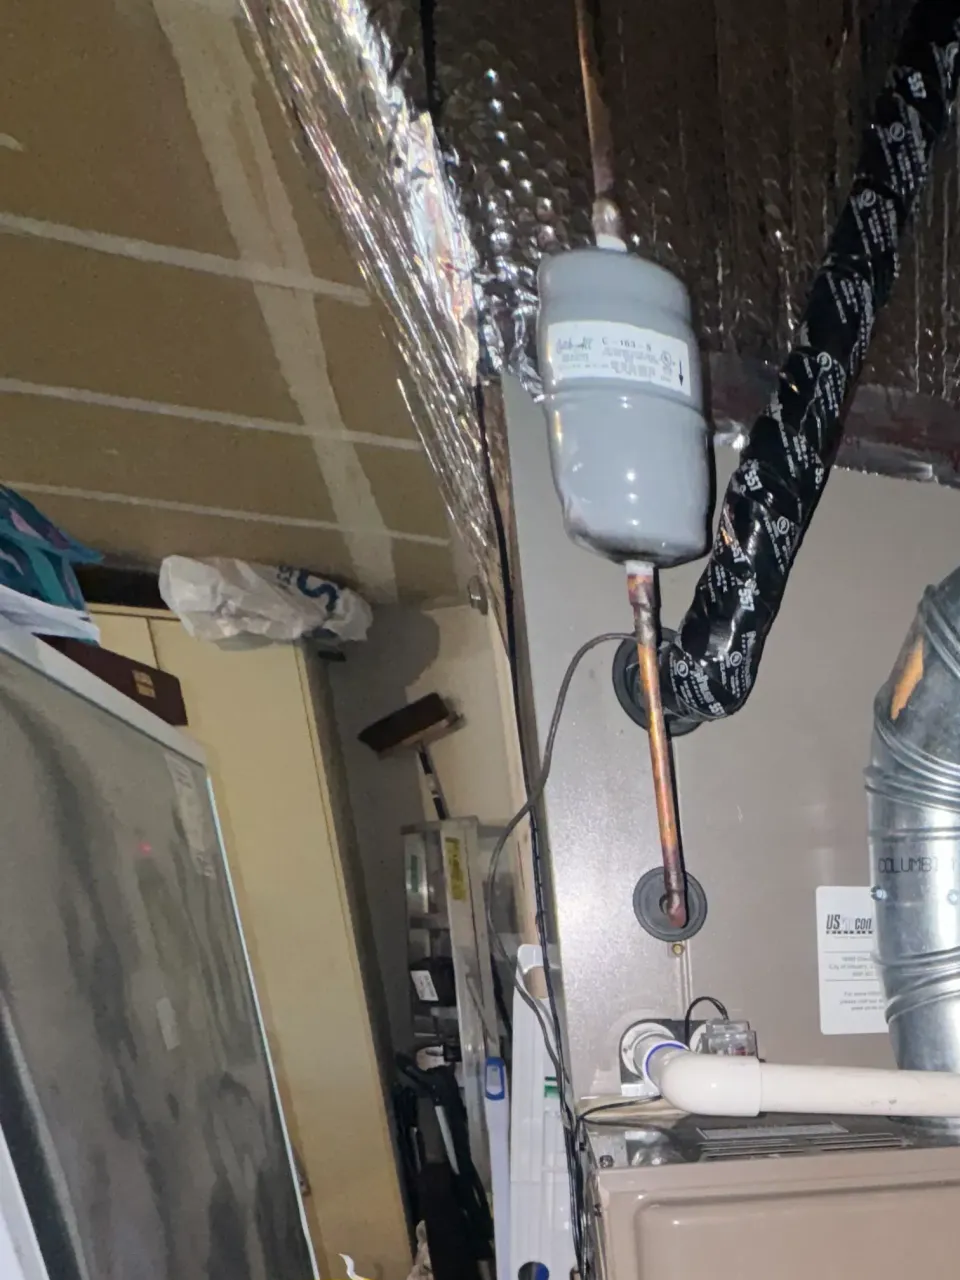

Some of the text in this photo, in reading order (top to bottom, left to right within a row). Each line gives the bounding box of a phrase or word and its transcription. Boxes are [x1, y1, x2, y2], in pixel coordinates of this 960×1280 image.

[907, 71, 926, 99] 557
[744, 470, 763, 492] 557
[730, 540, 746, 564] 557
[738, 587, 755, 612] 557
